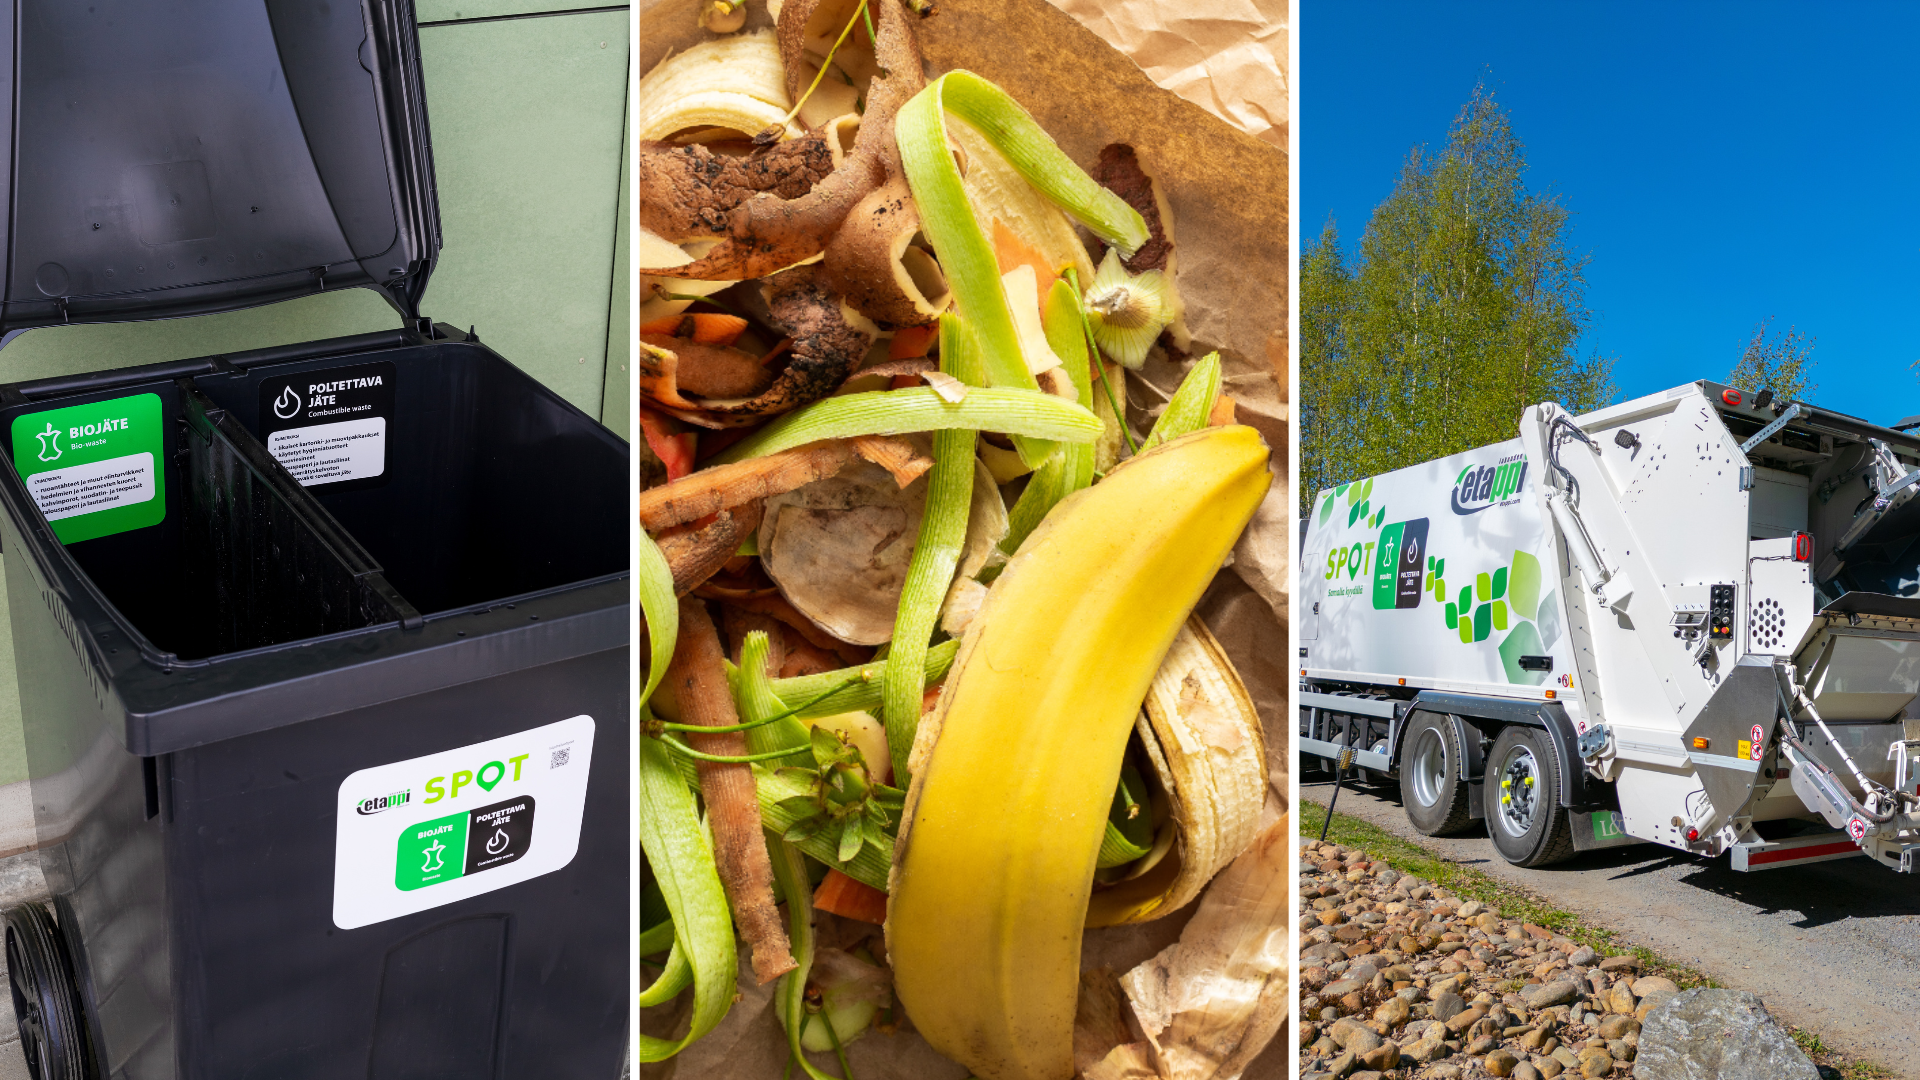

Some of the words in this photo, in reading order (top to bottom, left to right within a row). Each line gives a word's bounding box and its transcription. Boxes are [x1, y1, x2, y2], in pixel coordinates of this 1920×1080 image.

[309, 376, 383, 394] POLTETTAVA
[308, 395, 336, 408] JÄTE
[308, 406, 350, 418] Combustible
[70, 418, 128, 439] BIOJÄTE
[71, 439, 106, 450] Bio-waste
[1460, 454, 1528, 504] etappi
[40, 490, 72, 500] hedelmien
[1325, 541, 1375, 581] SPOT
[364, 788, 410, 811] etappi
[423, 753, 529, 804] SPOT
[476, 803, 525, 823] POLTETTAVA
[491, 816, 510, 827] JÄTE
[418, 824, 453, 839] BIOJÄTE
